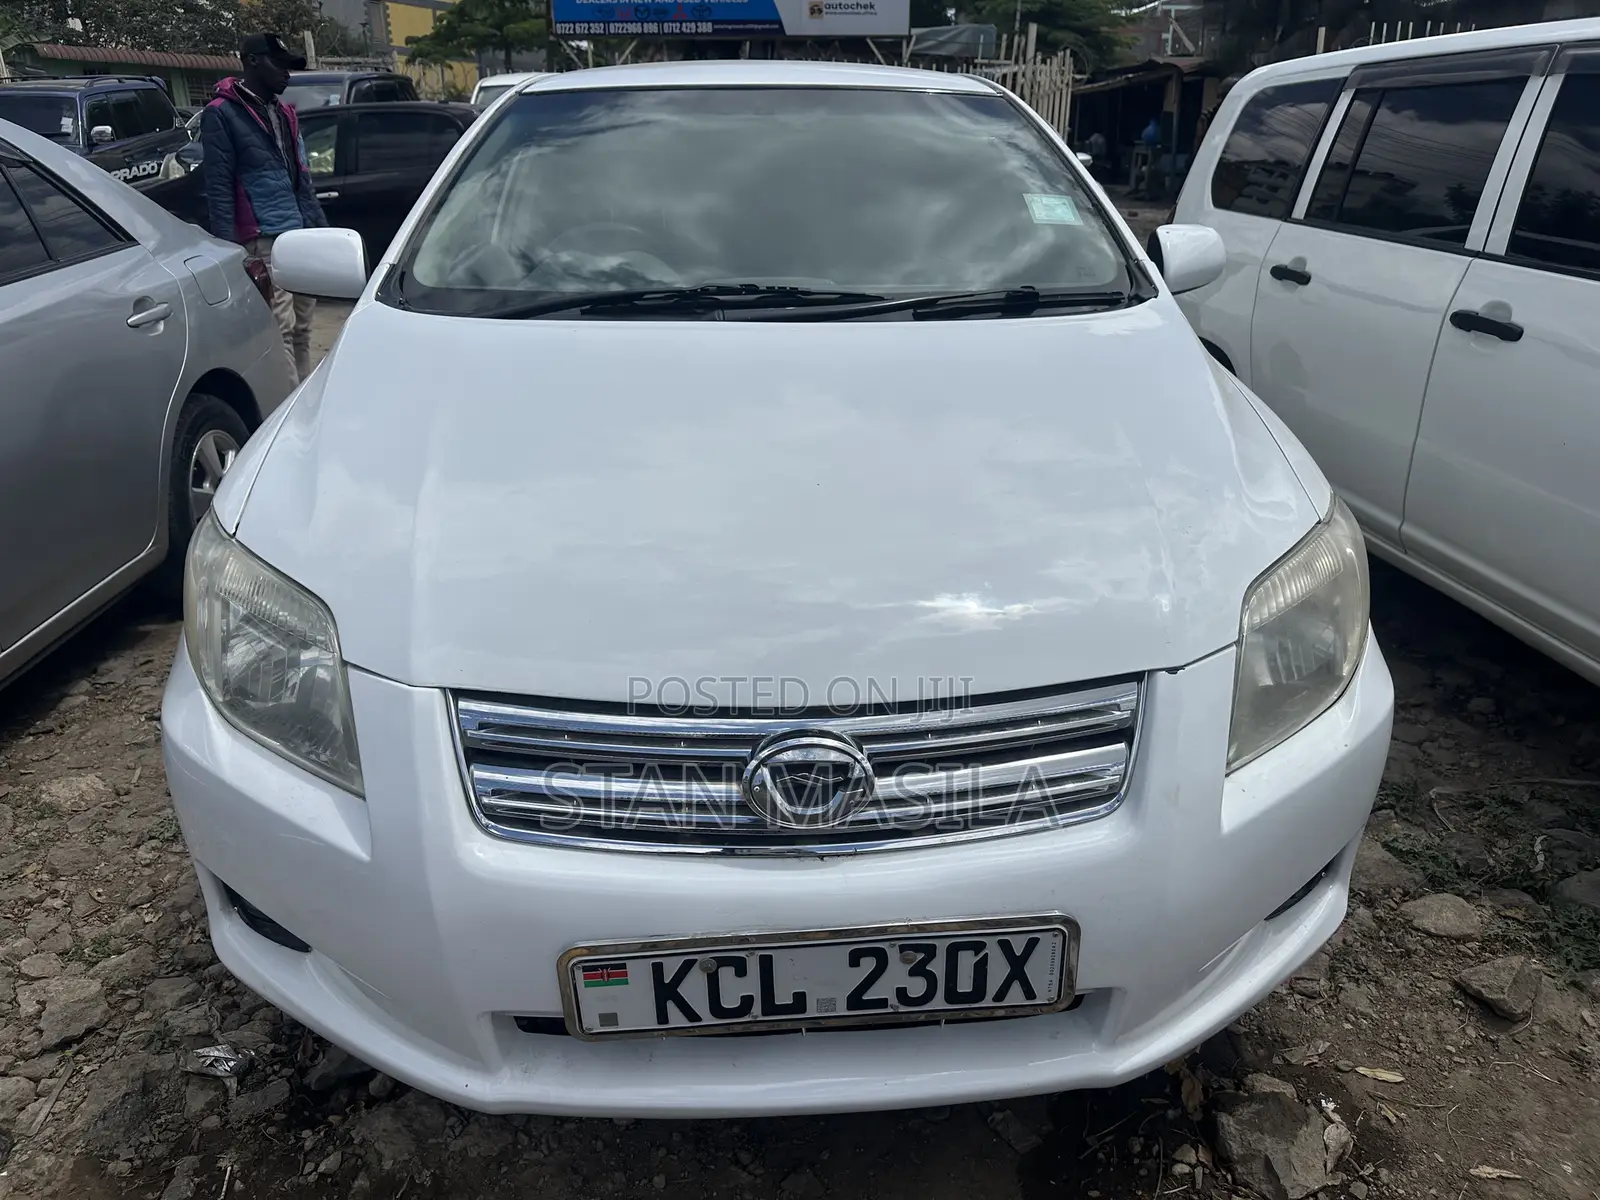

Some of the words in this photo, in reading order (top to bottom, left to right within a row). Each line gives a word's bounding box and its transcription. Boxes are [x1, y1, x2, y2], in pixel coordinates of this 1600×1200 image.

[824, 1, 876, 10] autochek
[110, 163, 158, 180] PRADO
[650, 952, 808, 1025] KCL
[845, 937, 1041, 1010] 230X
